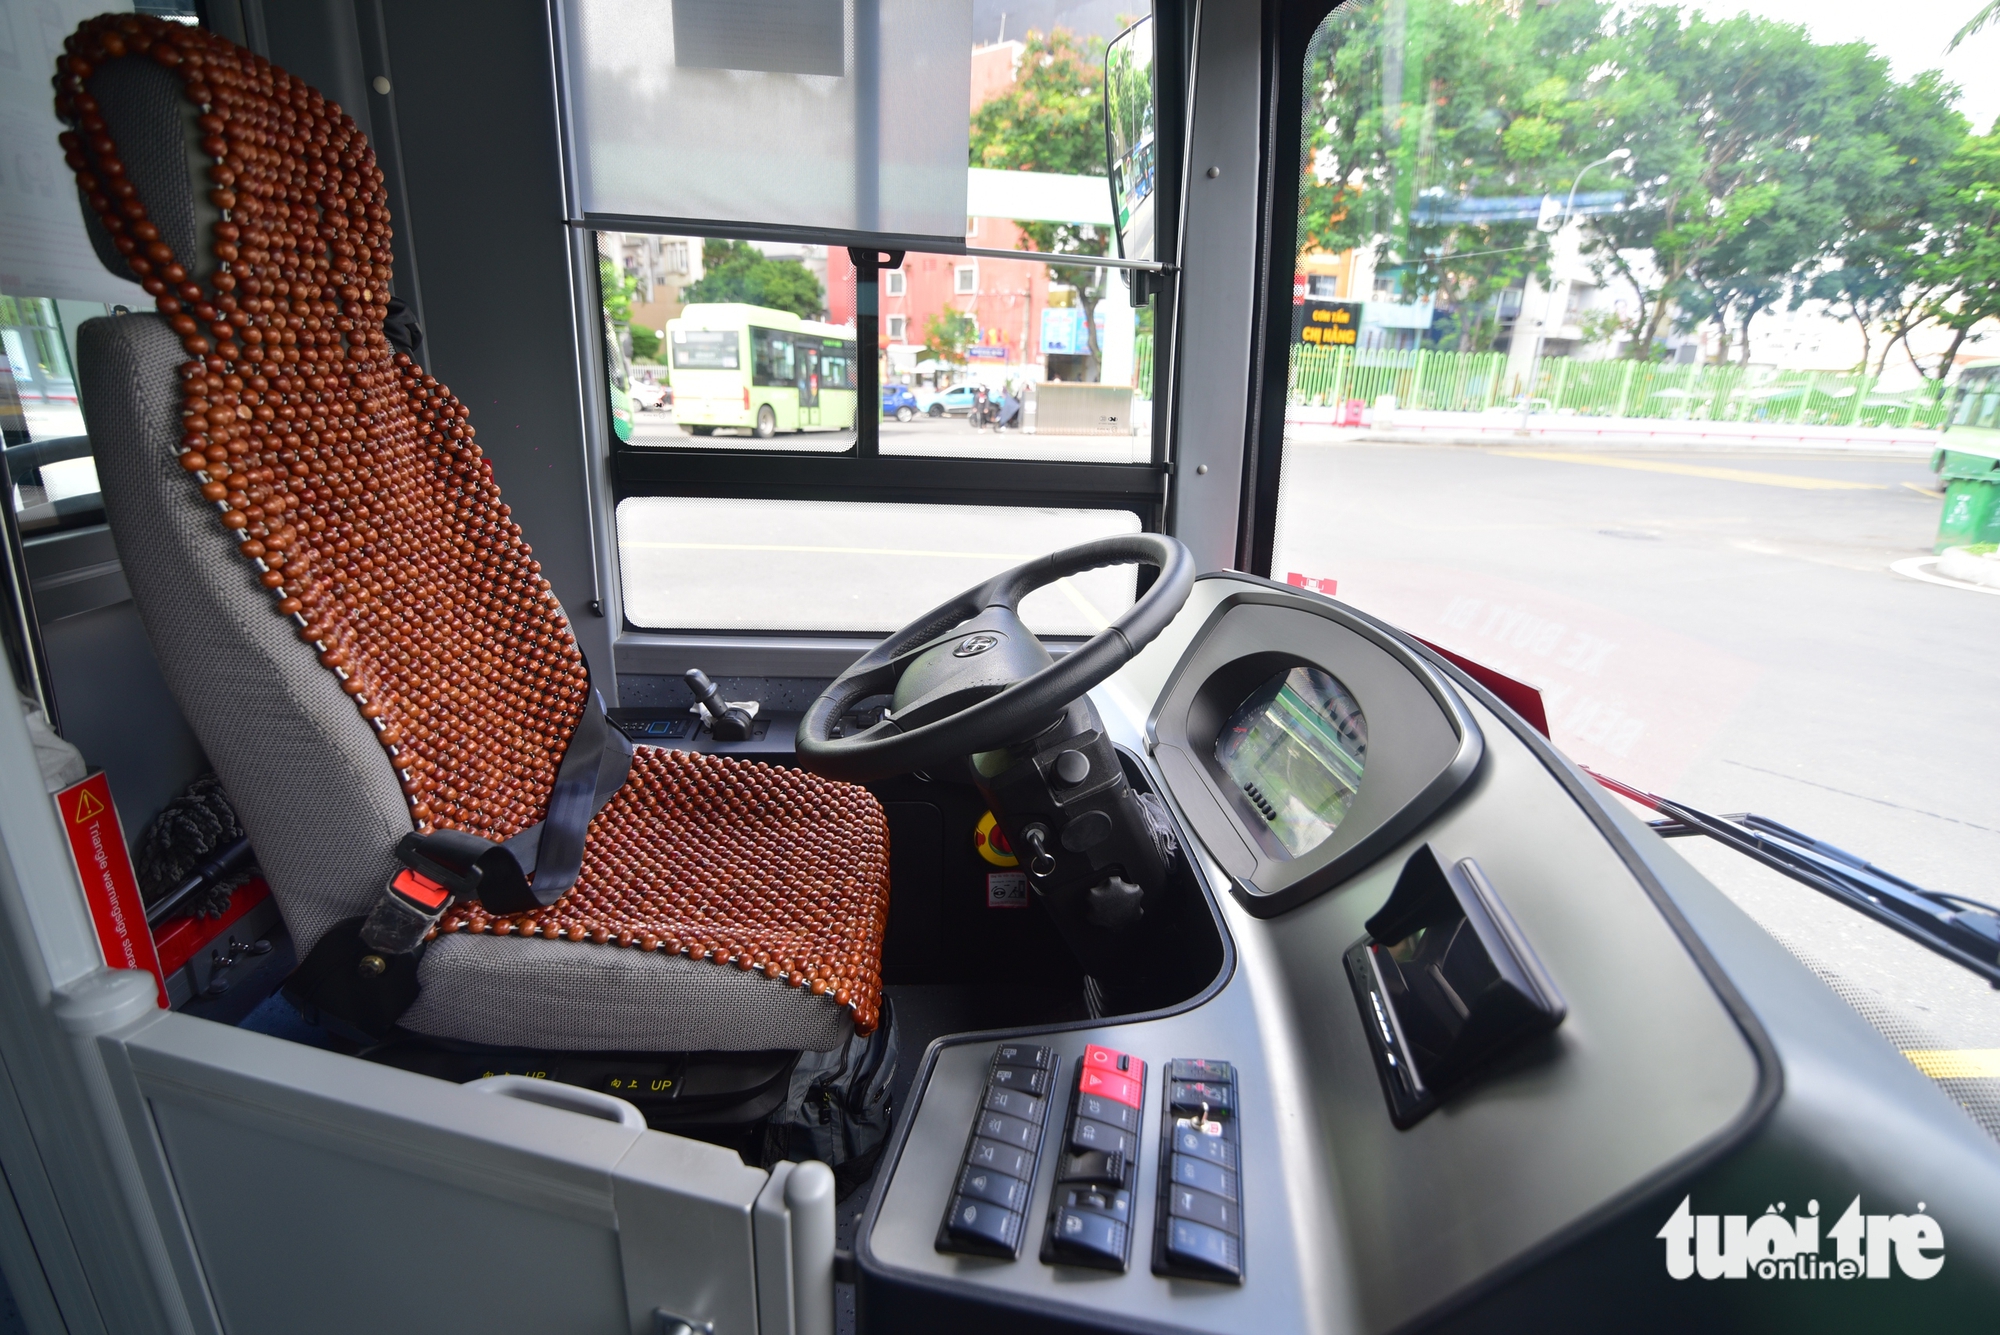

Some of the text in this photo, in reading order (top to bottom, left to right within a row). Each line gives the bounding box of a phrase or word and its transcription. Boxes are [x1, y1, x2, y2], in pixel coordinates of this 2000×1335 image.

[89, 821, 108, 870] Triangle
[102, 870, 128, 938] warningsign
[651, 1079, 672, 1091] UP
